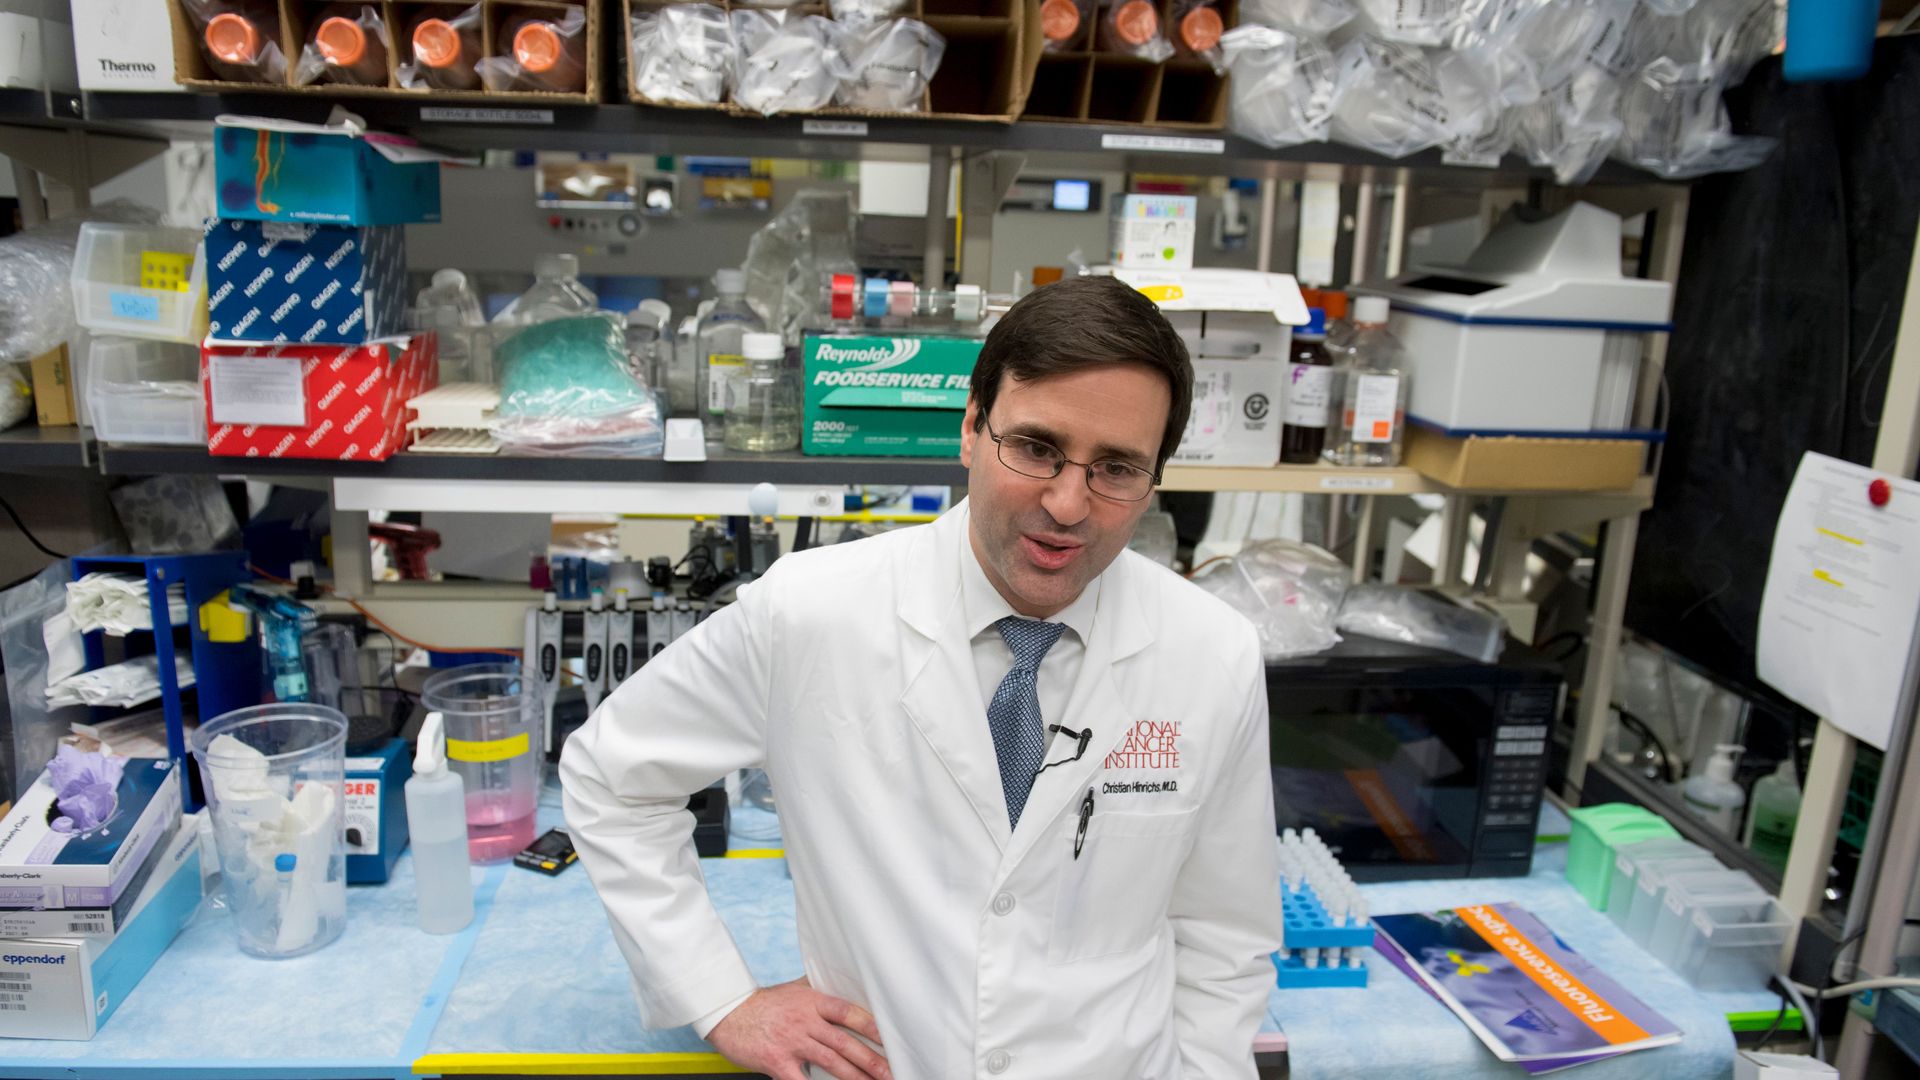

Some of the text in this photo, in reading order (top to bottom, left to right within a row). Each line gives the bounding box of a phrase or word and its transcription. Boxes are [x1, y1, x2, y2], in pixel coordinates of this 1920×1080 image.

[98, 58, 156, 72] Thermo
[285, 253, 315, 284] QIAGEN
[311, 278, 342, 310] QIAGEN
[231, 306, 262, 337] QIAGEN
[815, 343, 892, 364] Reynolds
[813, 370, 972, 390] FOODSERVICE FIL
[812, 420, 845, 432] 2000
[1127, 720, 1181, 737] IONAL
[1113, 735, 1177, 755] ANCER
[1104, 752, 1180, 769] INSTITUTE
[1102, 782, 1131, 794] Christian
[1162, 780, 1178, 792] M.D.
[3, 954, 66, 965] eppendorf
[1502, 937, 1614, 1024] Fluorescence
